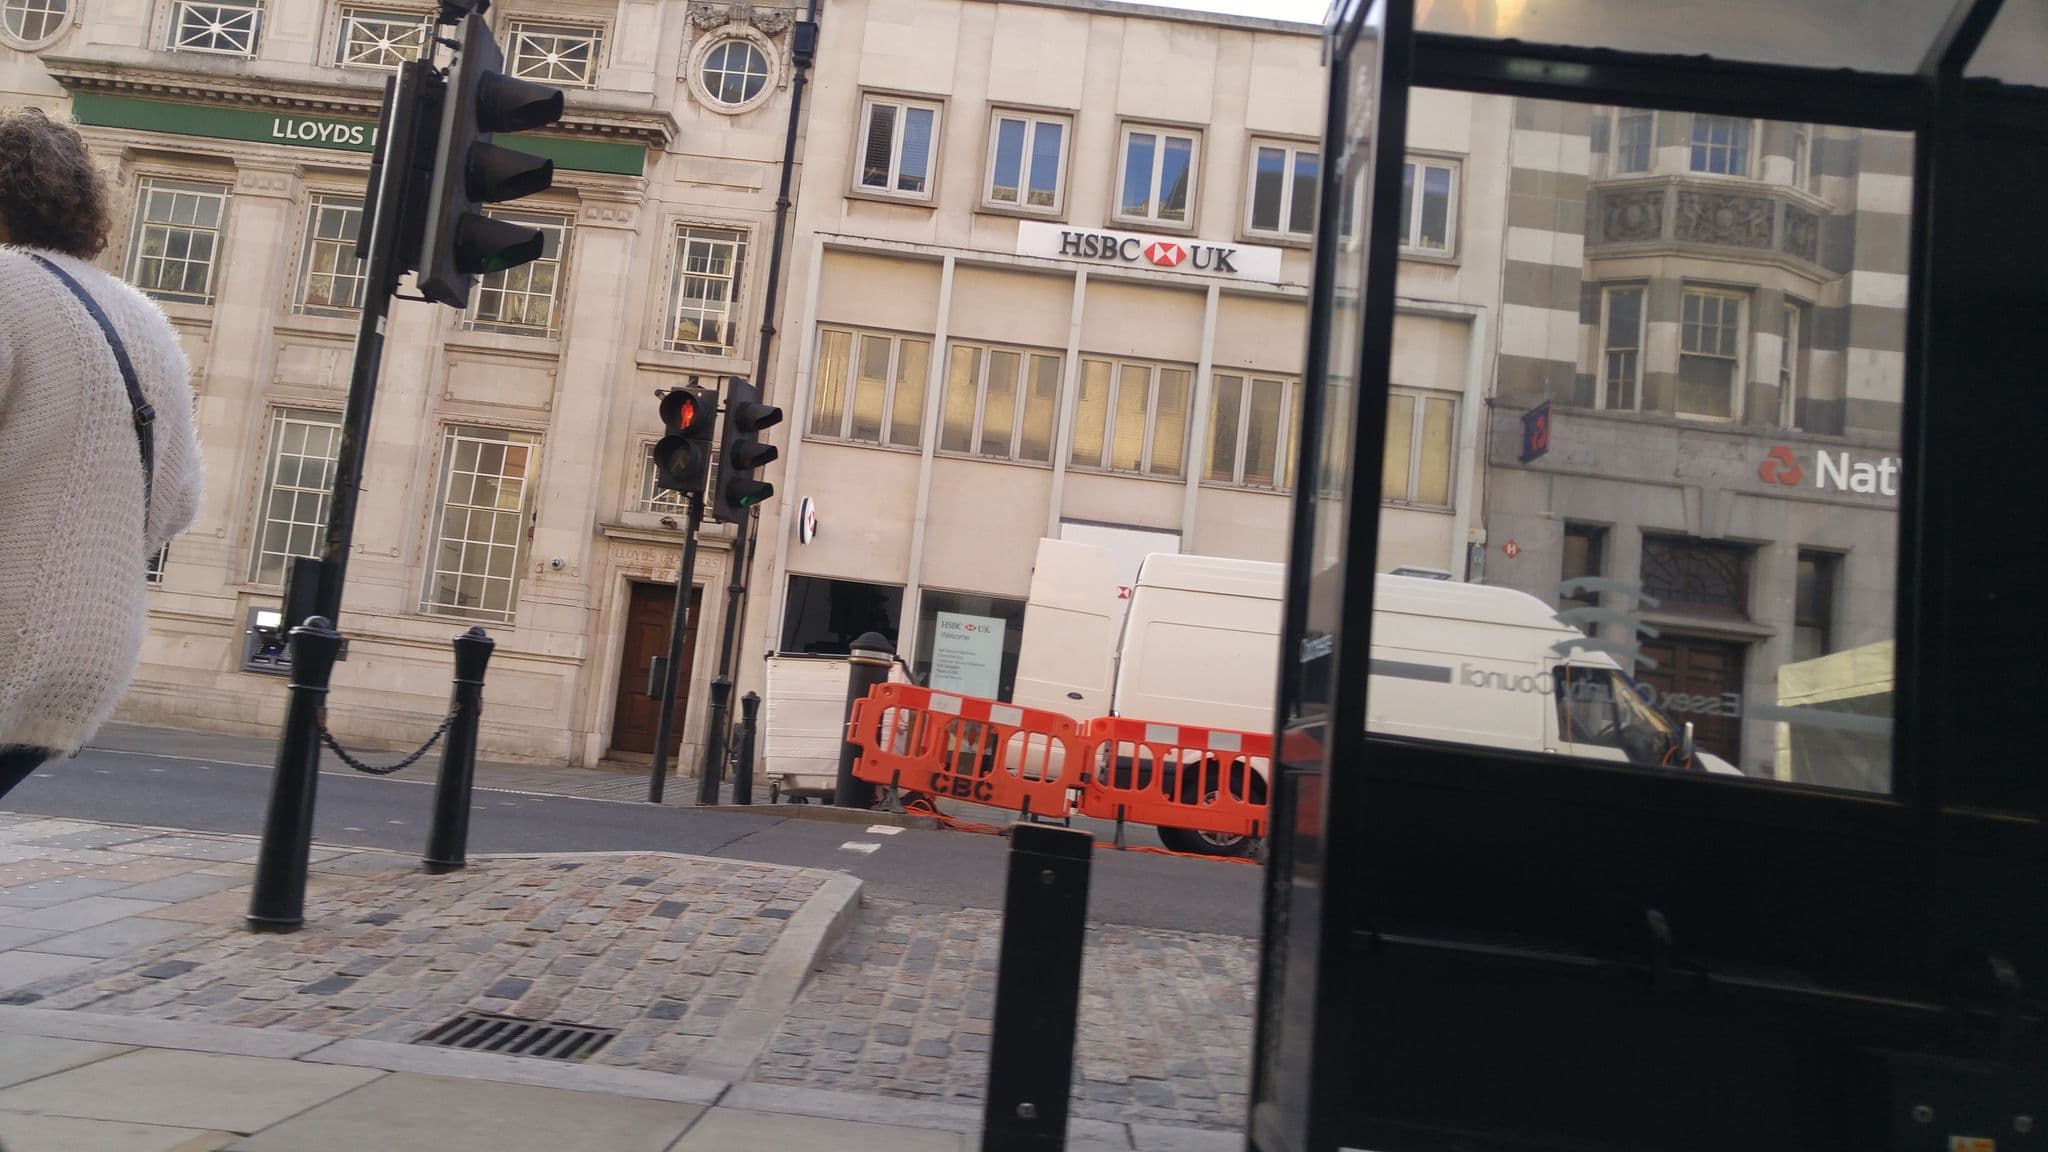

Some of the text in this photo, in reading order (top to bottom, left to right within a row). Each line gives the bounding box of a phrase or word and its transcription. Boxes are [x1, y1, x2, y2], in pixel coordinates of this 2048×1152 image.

[272, 118, 364, 145] LLOYDS
[1058, 231, 1238, 272] HSBC UK
[1816, 450, 1902, 496] Nat
[614, 547, 719, 569] LLOYDS CHAERS
[931, 772, 993, 801] CBC
